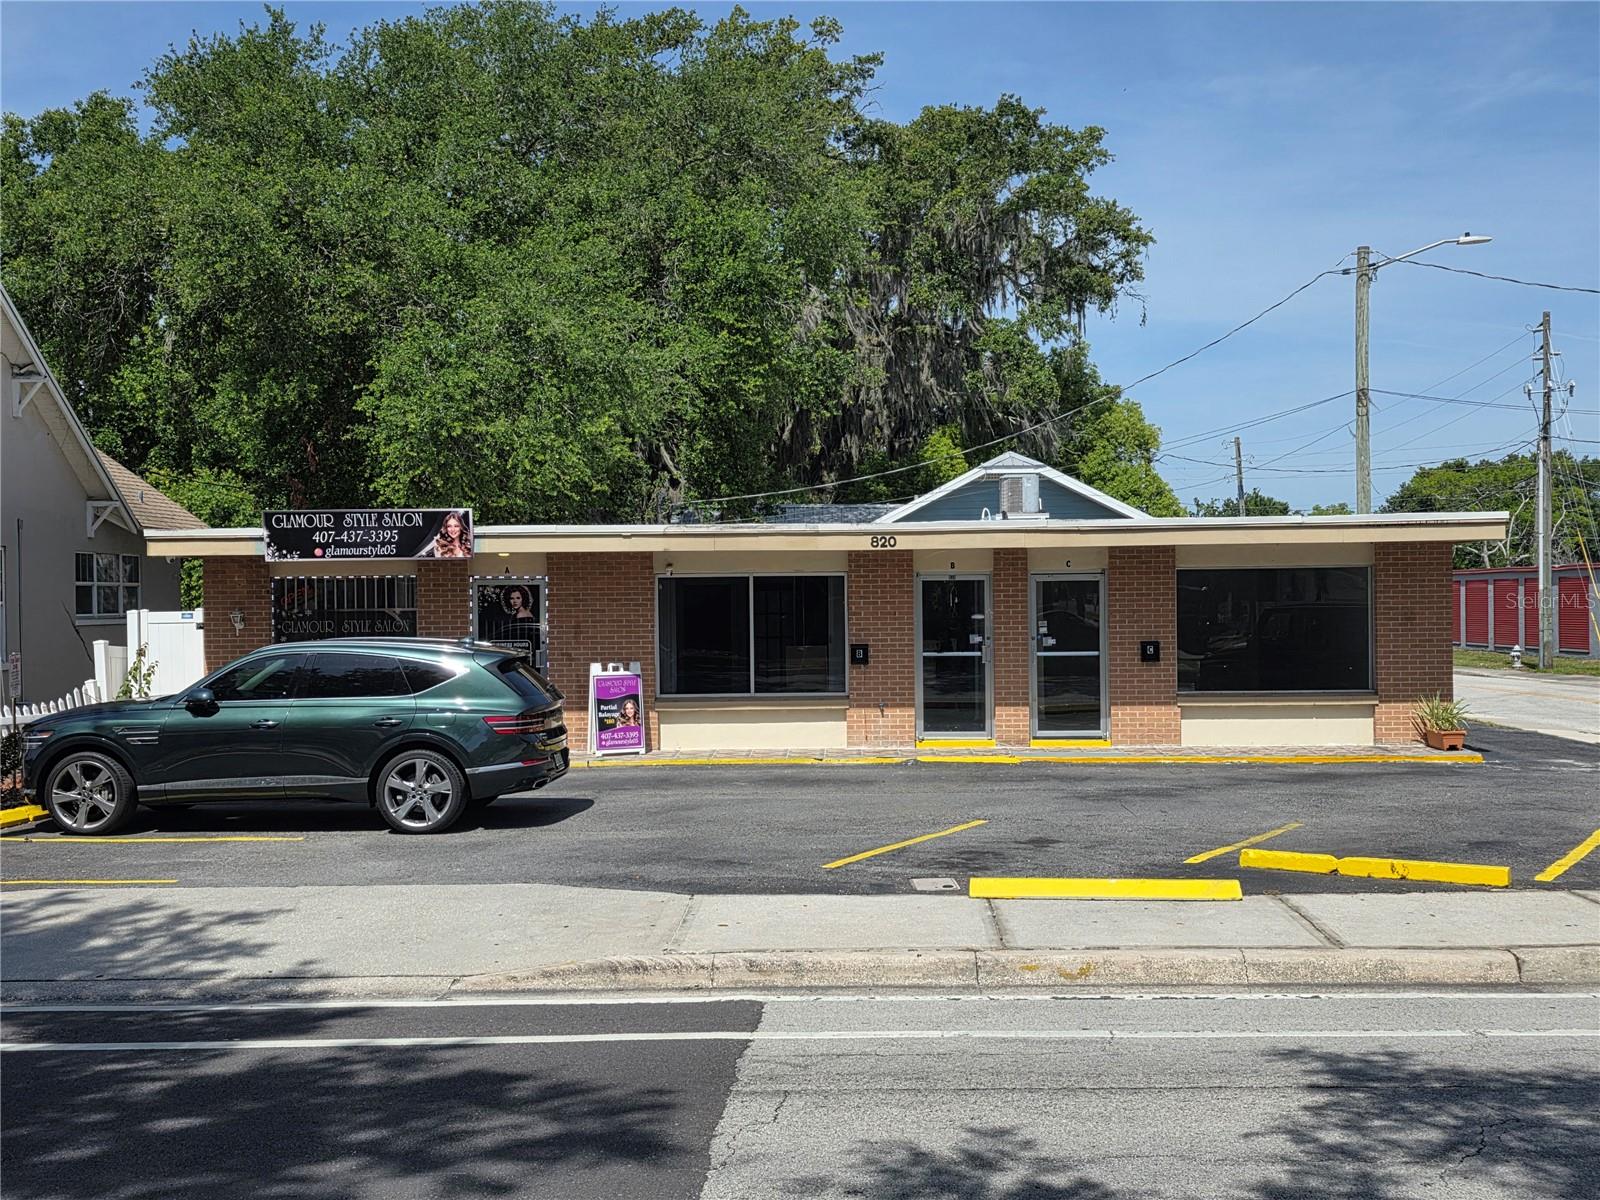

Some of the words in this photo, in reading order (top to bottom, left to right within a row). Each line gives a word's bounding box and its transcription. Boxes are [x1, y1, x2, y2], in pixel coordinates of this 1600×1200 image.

[272, 514, 334, 529] GLAMOUR
[343, 513, 378, 527] STYLE
[382, 512, 423, 527] SALON
[312, 530, 399, 543] 407-437-3395
[870, 536, 897, 548] 820
[325, 545, 396, 558] glamourstyle05
[504, 566, 510, 574] A
[1066, 560, 1071, 568] C
[281, 620, 334, 634] GLAMOUR
[341, 620, 372, 633] STYLE
[374, 619, 409, 632] SALON
